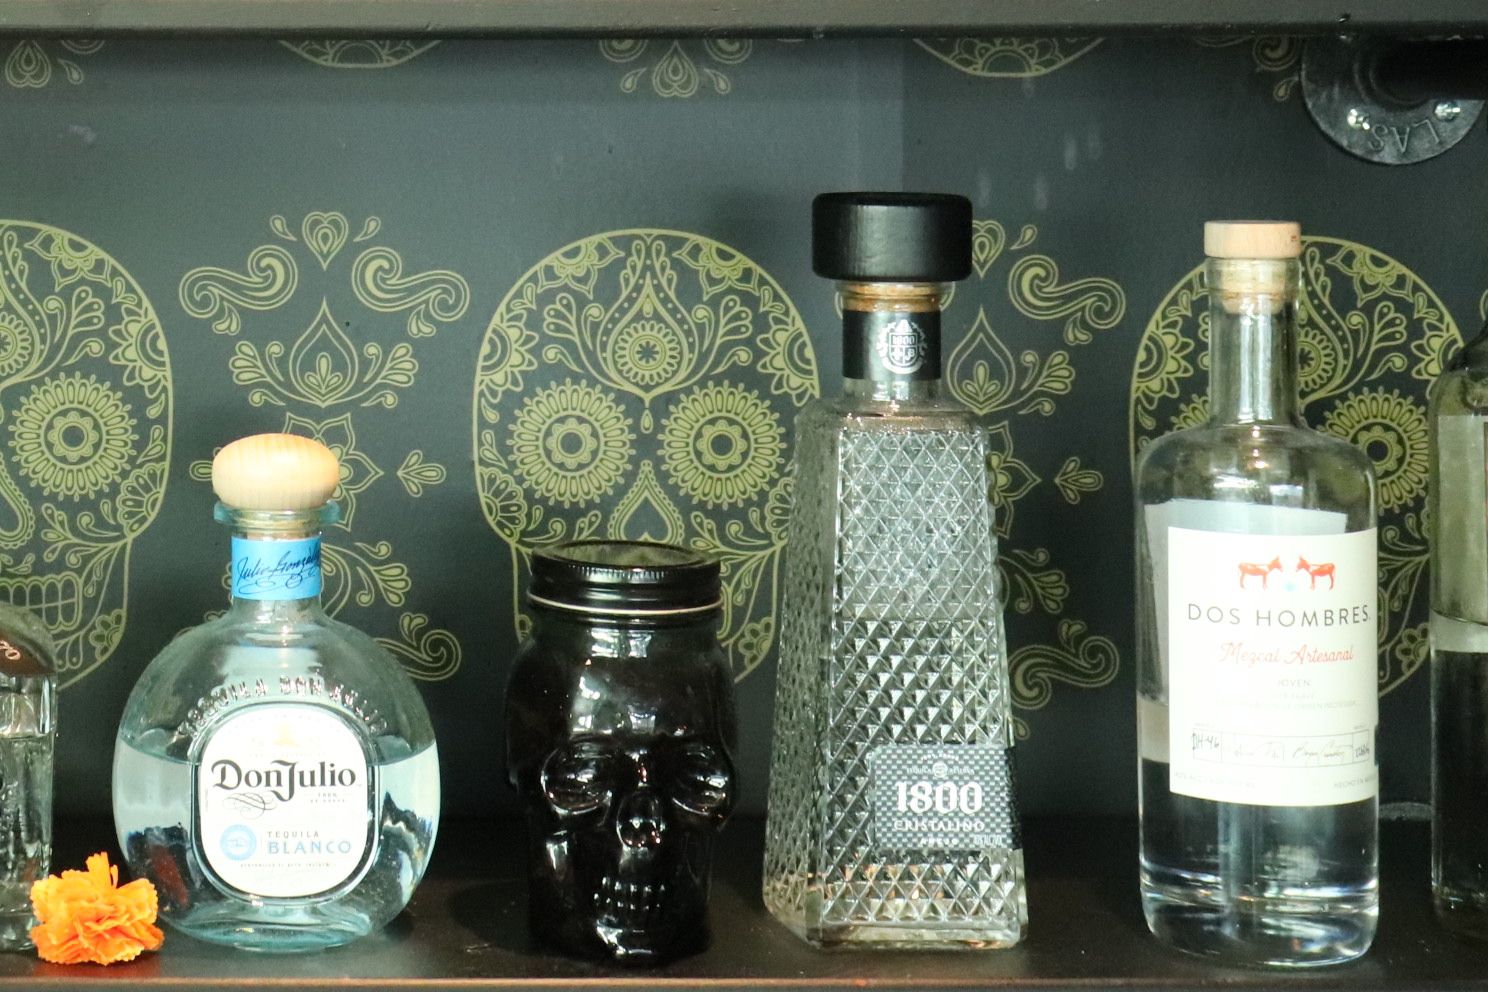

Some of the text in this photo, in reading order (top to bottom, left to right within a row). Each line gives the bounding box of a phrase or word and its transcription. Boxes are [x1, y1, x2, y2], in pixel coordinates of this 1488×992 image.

[1188, 602, 1369, 628] DOS HOMBRES
[1217, 641, 1355, 667] Mezcal Artesanal
[894, 780, 982, 815] 1800
[267, 830, 320, 839] TEQUILA
[893, 819, 985, 832] CRISTALINO
[267, 840, 352, 855] BLANCO
